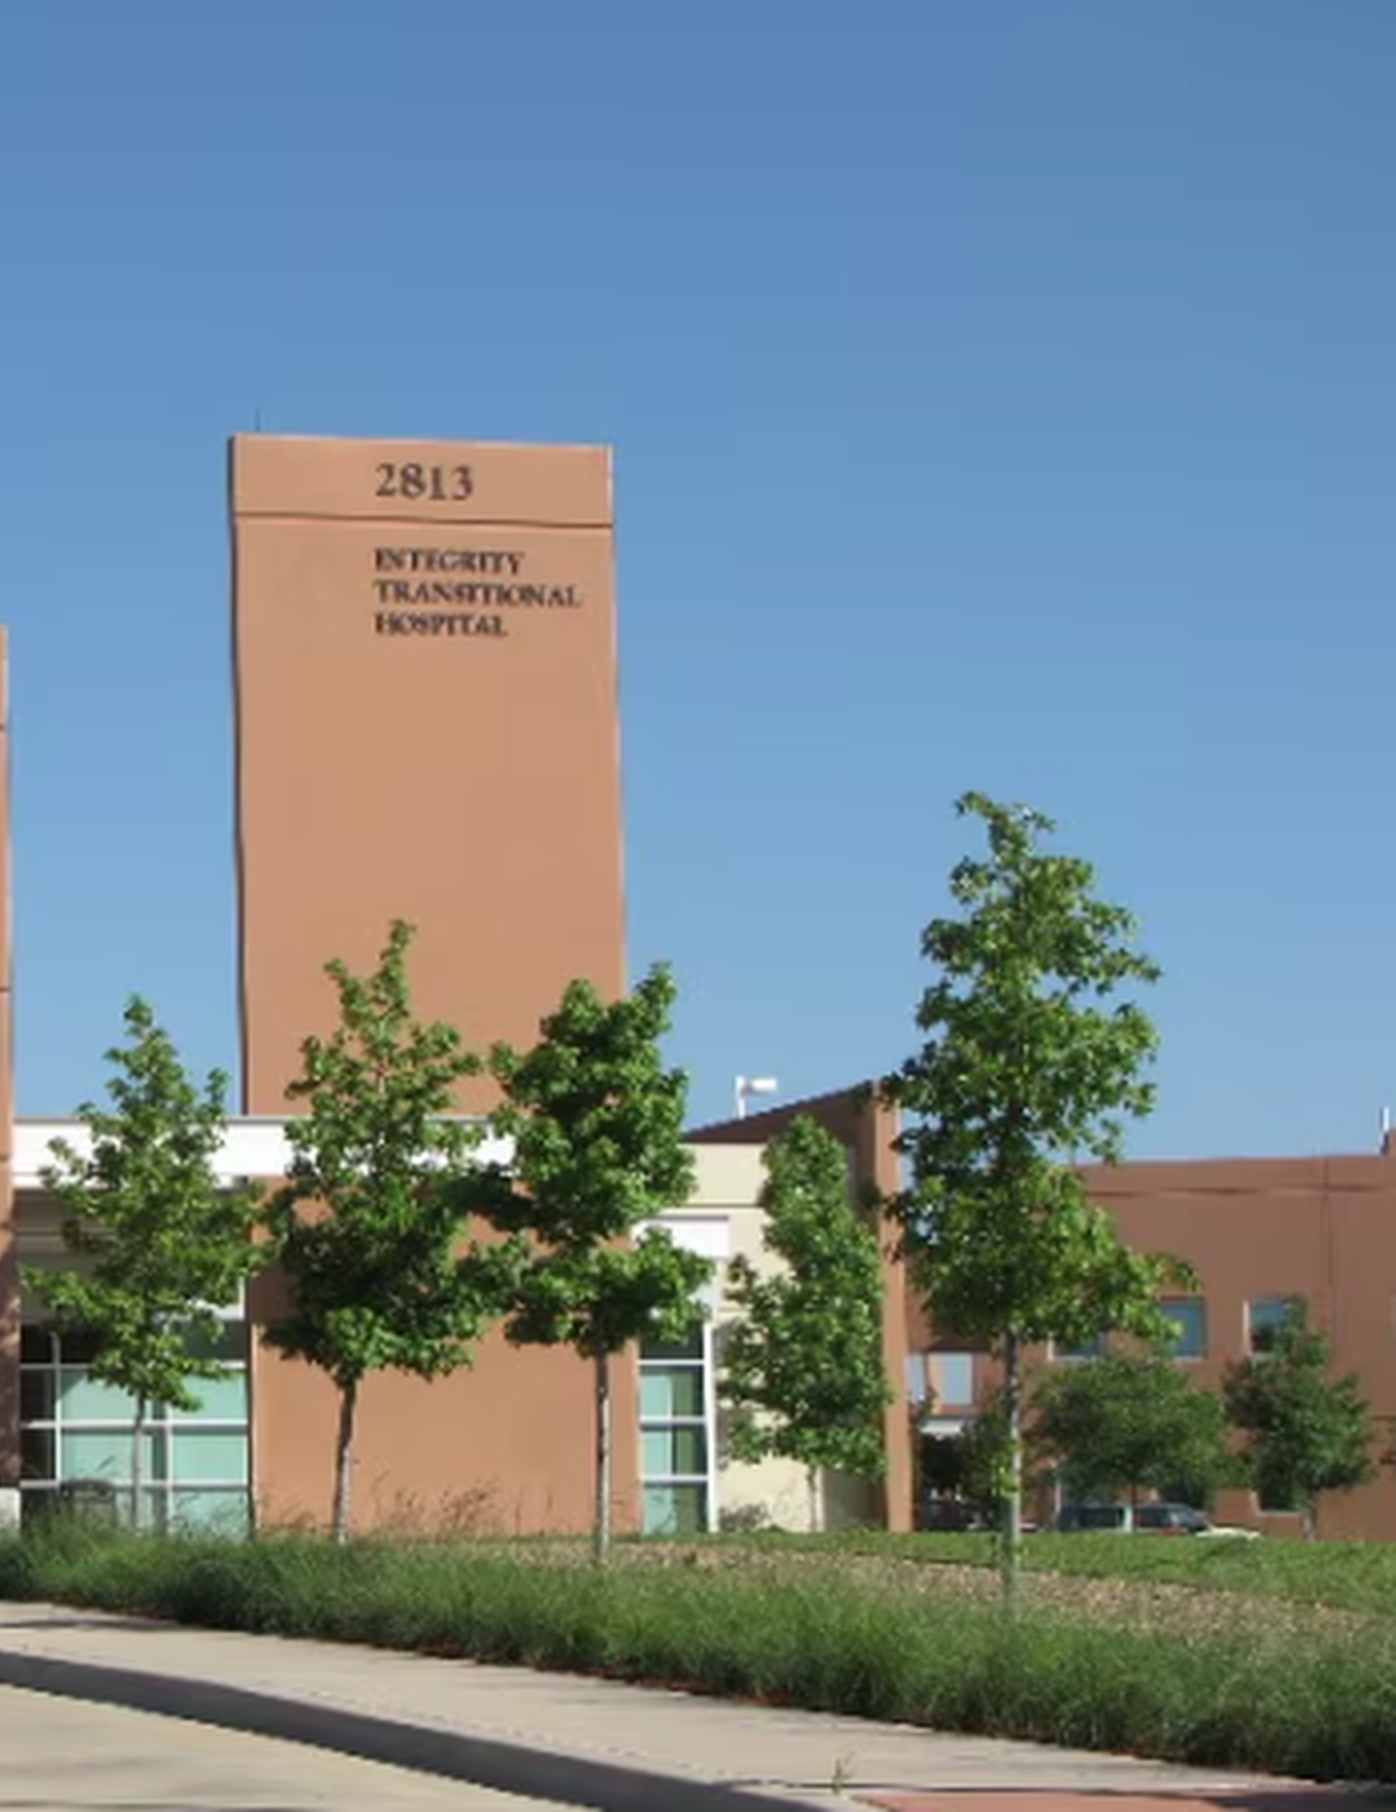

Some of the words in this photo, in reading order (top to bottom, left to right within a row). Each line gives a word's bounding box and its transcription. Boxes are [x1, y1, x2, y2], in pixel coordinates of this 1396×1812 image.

[375, 463, 474, 500] 2813
[374, 549, 525, 574] INTEGRITY
[373, 579, 582, 607] TRANSITIONAL
[374, 612, 508, 636] HOSPITAL
